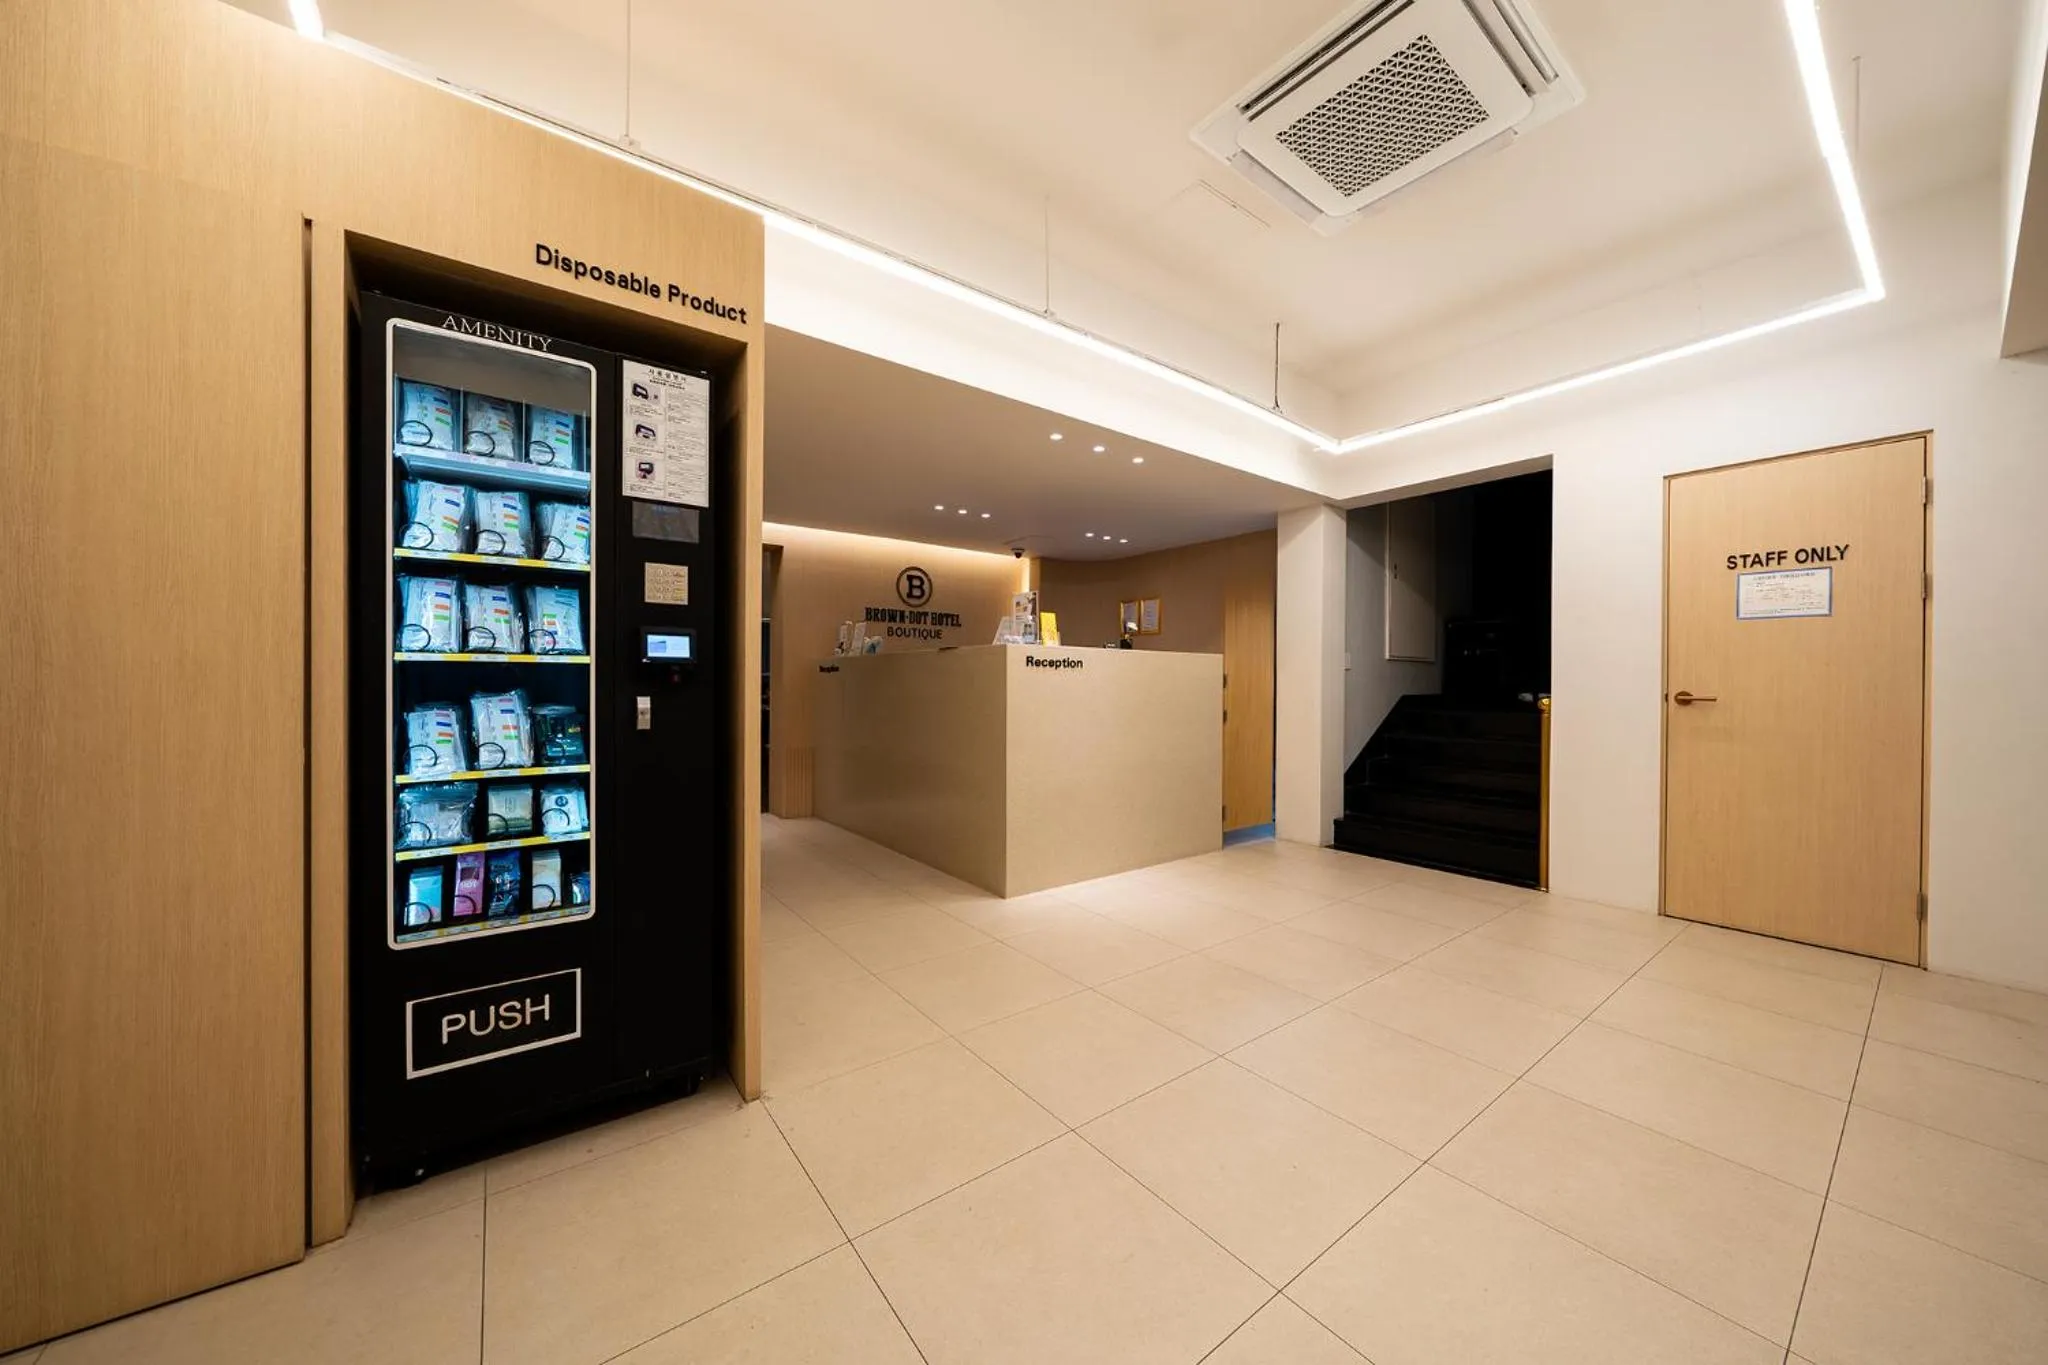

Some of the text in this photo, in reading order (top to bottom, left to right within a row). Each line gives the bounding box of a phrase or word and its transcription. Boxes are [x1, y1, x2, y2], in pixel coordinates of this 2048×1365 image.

[536, 243, 748, 324] Disposable Product
[441, 315, 552, 351] AMENITY
[1727, 544, 1850, 570] STAFF ONLY
[906, 574, 925, 599] B
[931, 612, 962, 627] HOTEL
[886, 626, 943, 640] BOUTIQUE
[1025, 655, 1084, 670] Reception
[441, 993, 551, 1046] PUSH
